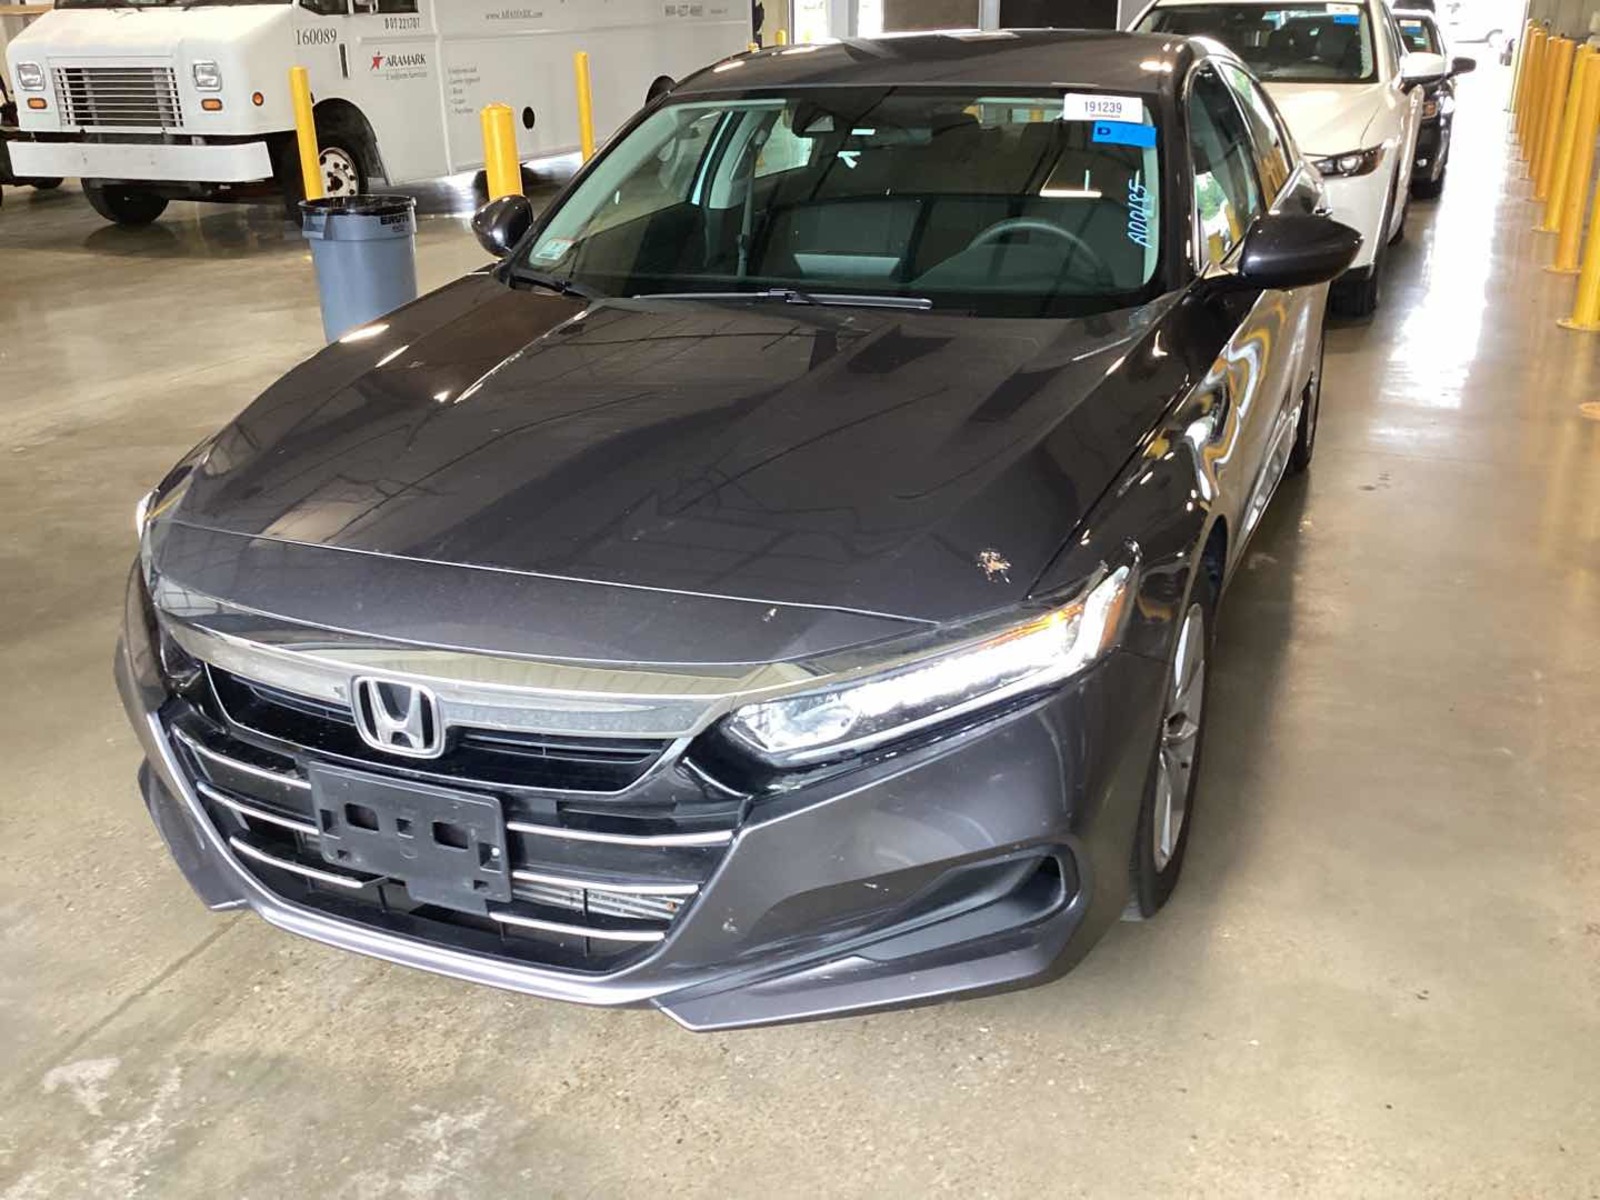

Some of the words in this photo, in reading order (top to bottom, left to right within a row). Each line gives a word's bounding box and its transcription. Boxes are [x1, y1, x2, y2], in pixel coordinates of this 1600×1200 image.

[296, 28, 337, 46] 160089
[385, 53, 426, 67] ARAMARK
[1084, 100, 1122, 114] 191239
